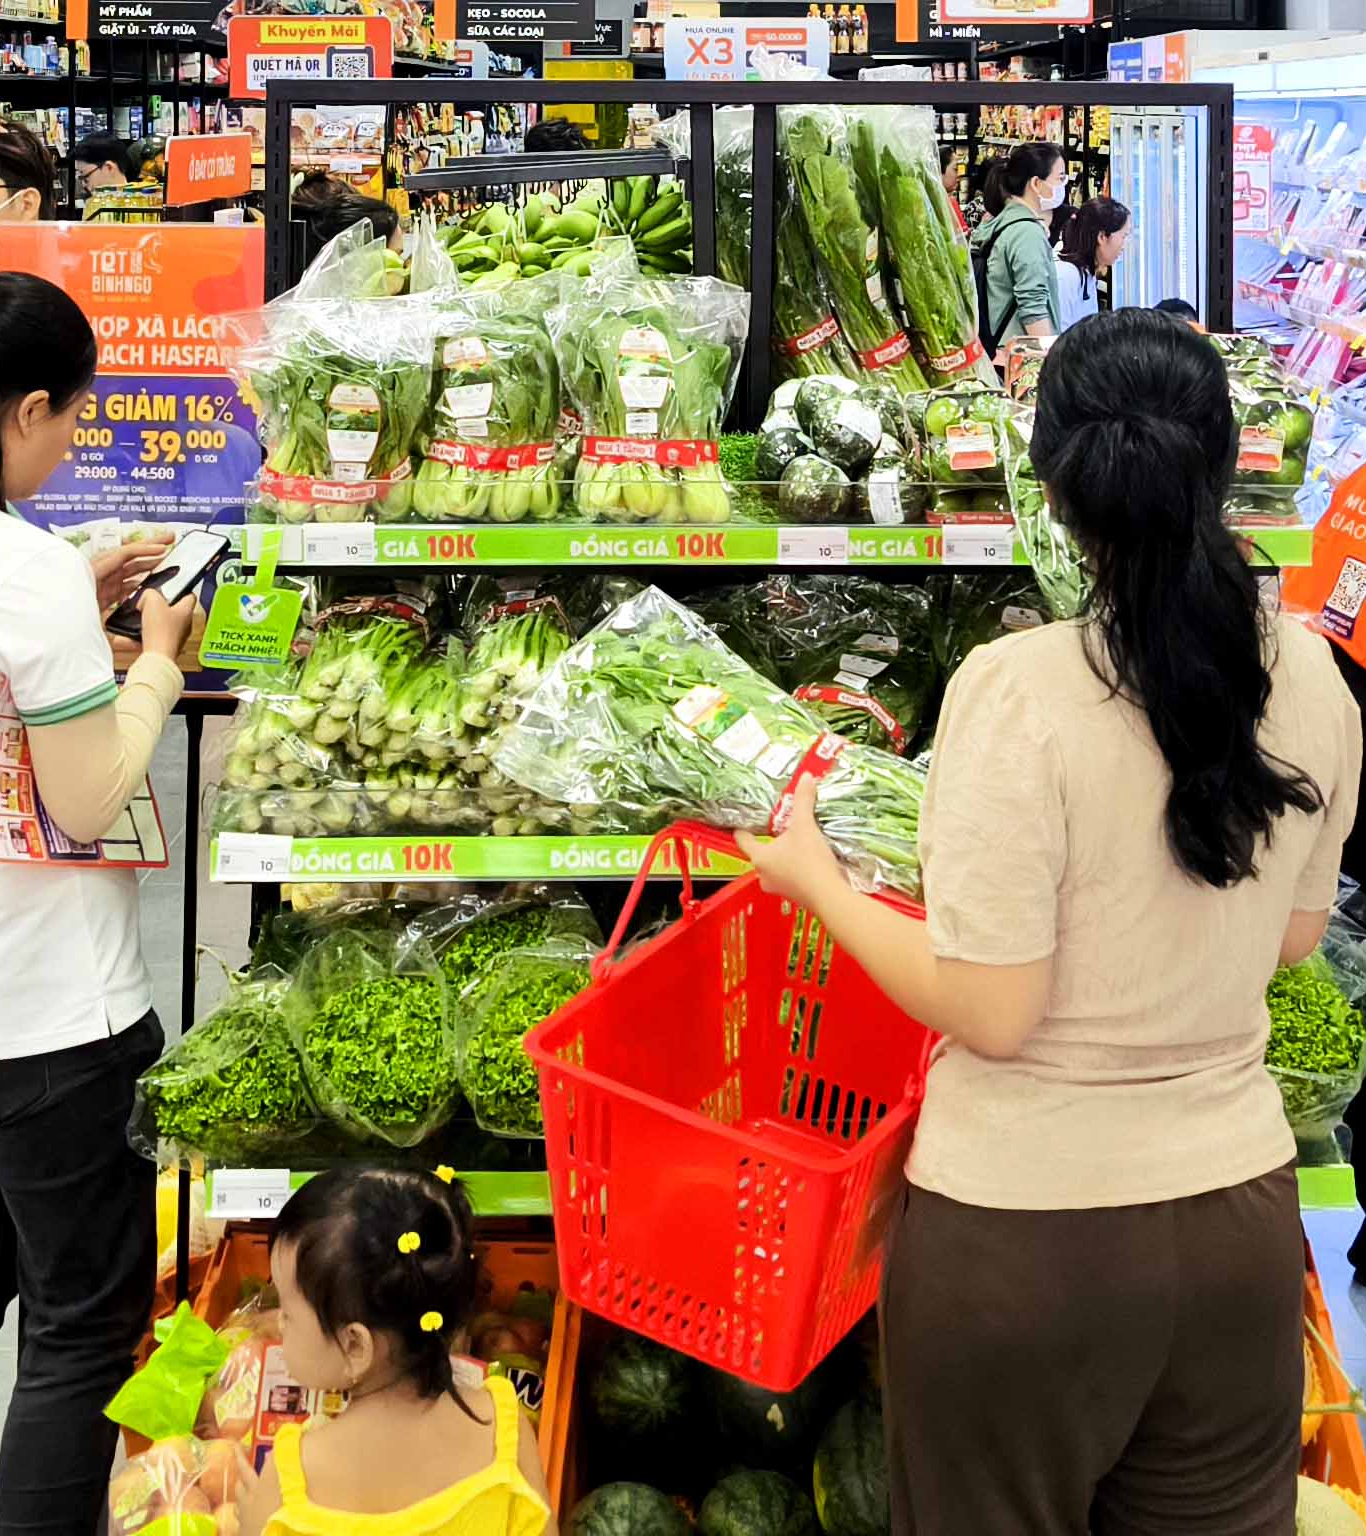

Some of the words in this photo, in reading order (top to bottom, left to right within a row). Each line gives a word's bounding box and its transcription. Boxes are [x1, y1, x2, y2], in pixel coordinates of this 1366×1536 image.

[501, 7, 546, 20] SOCOLA
[492, 23, 515, 38] CÁC
[686, 36, 735, 66] X3
[305, 58, 321, 72] QR
[105, 388, 176, 421] GIẢM
[184, 395, 234, 422] 16%
[383, 531, 419, 557] GIÁ
[426, 533, 476, 560] 10K
[570, 526, 629, 557] ĐỒNG
[635, 530, 669, 557] GIÁ
[676, 532, 726, 559] 10K
[881, 534, 916, 559] GIÁ
[345, 546, 359, 556] 10
[818, 547, 832, 557] 10
[982, 547, 996, 557] 10
[358, 846, 395, 872] GIÁ
[401, 843, 453, 871] 10K
[550, 842, 610, 870] ĐỒNG
[259, 860, 273, 872] 10
[258, 1197, 272, 1209] 10
